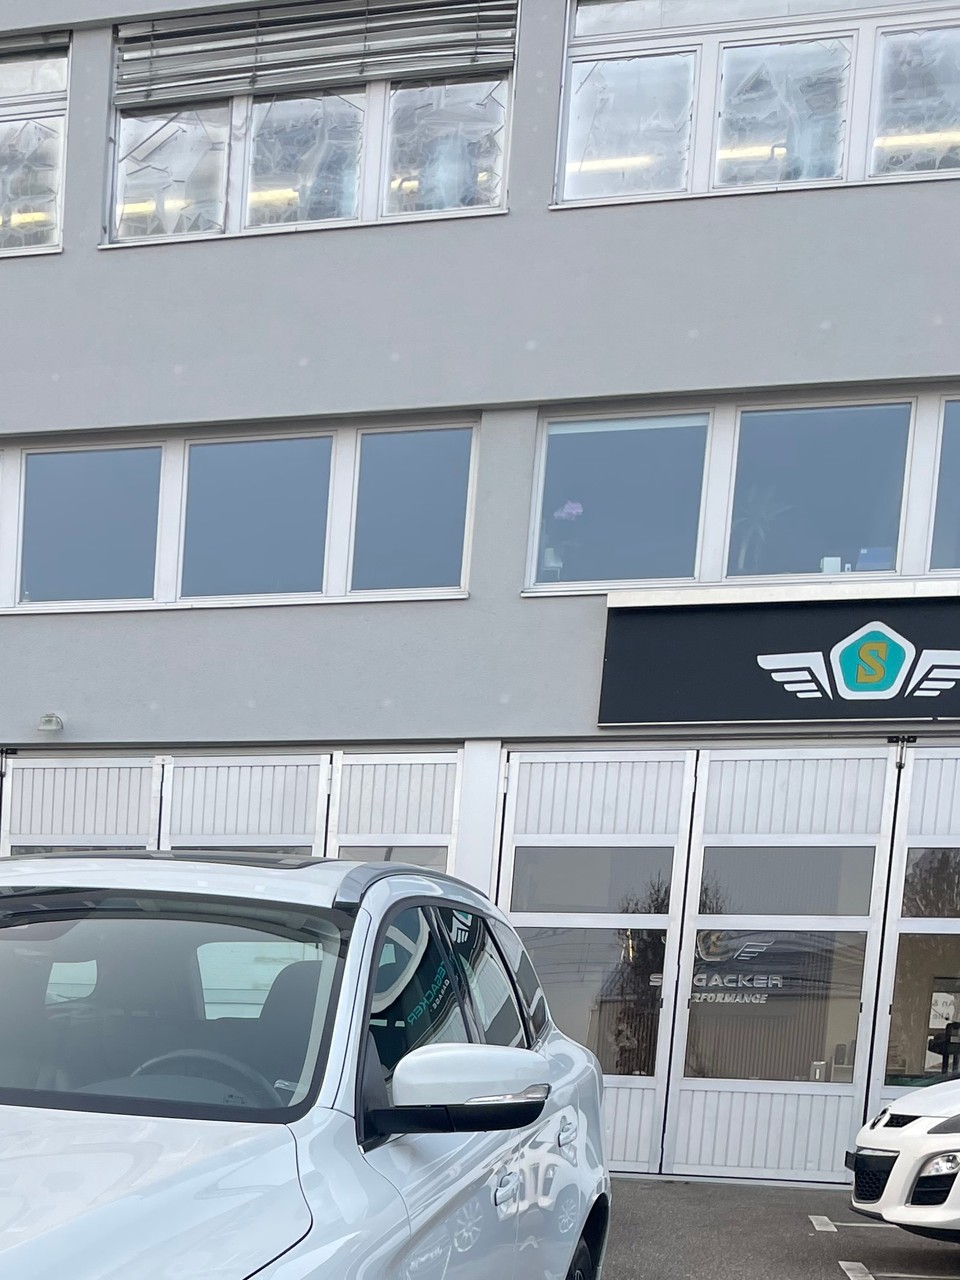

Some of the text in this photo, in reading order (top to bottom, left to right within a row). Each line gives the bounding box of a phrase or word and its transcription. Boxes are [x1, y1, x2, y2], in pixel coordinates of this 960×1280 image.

[857, 642, 888, 683] S
[649, 973, 783, 988] SGACKER
[691, 993, 769, 1004] RFORMANCE
